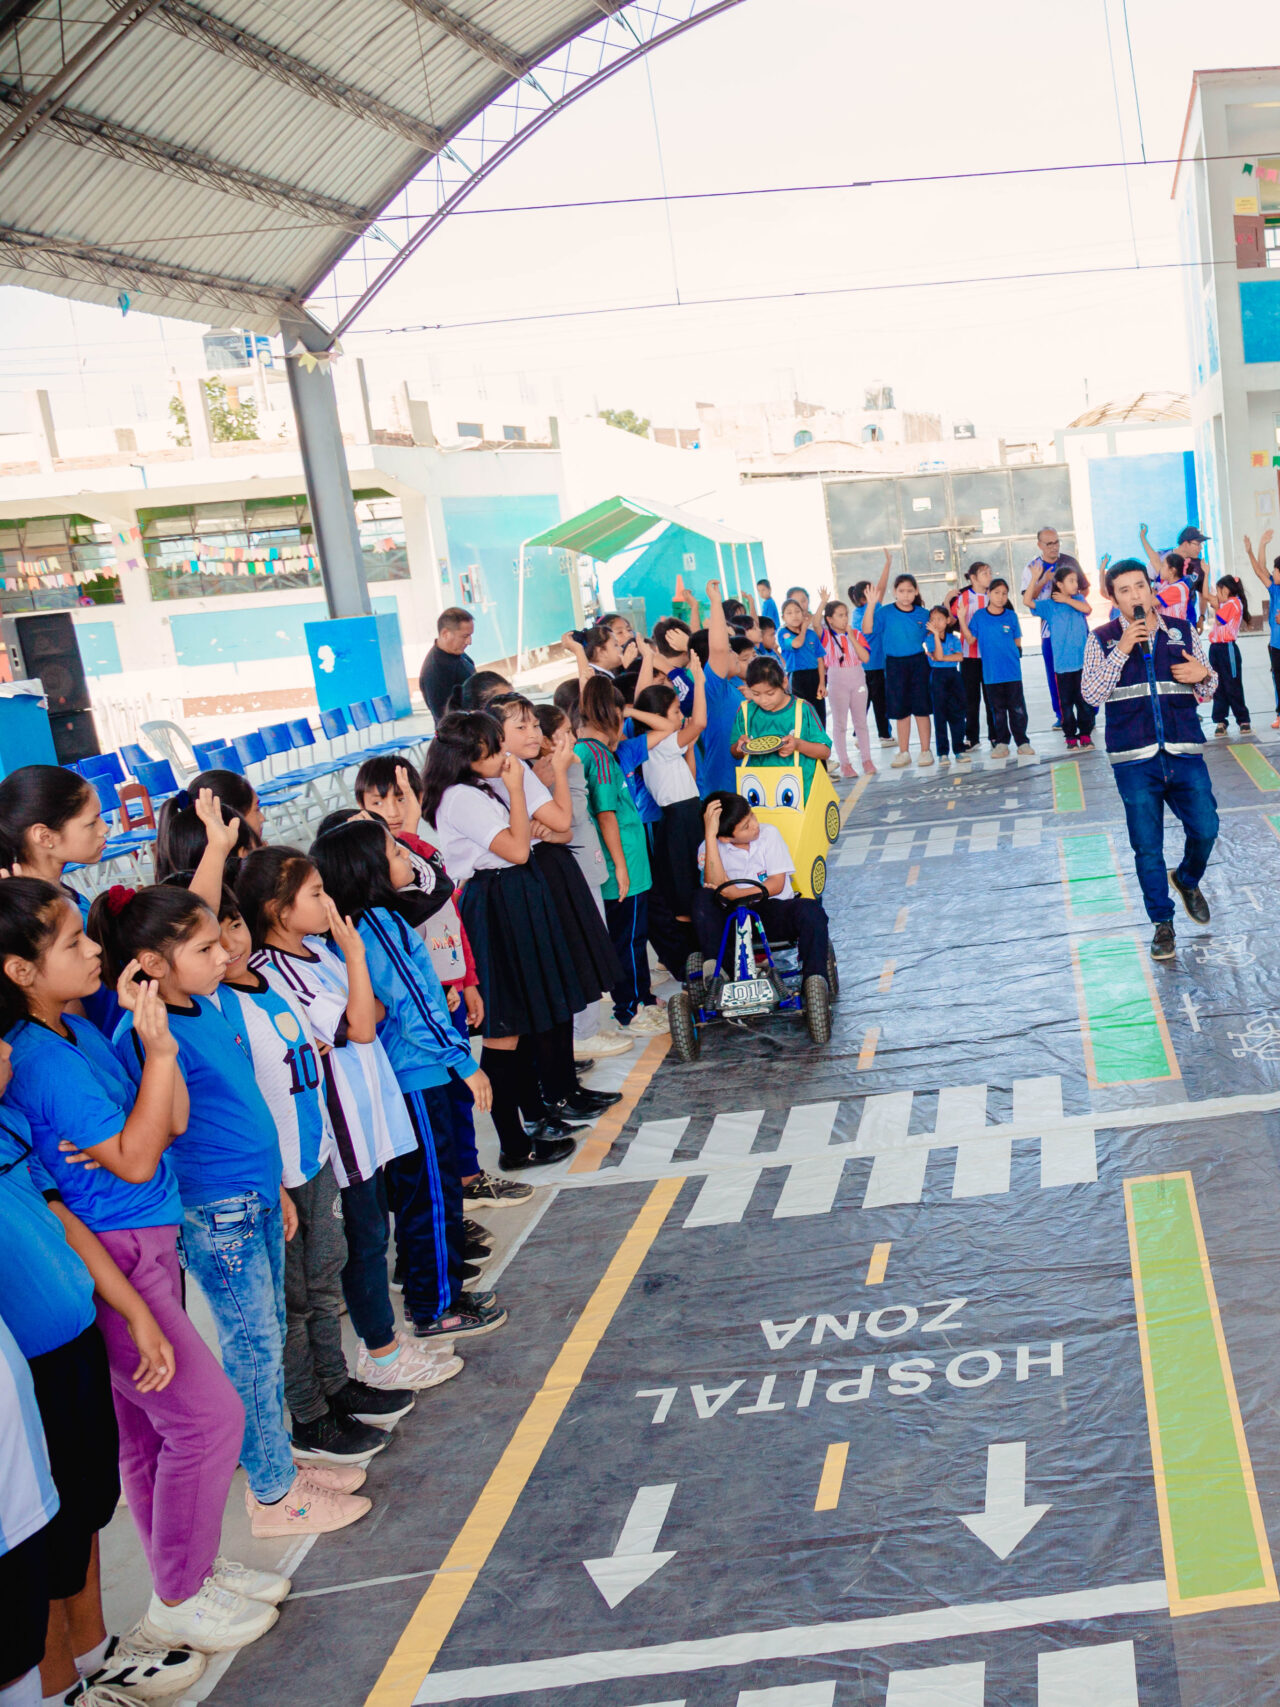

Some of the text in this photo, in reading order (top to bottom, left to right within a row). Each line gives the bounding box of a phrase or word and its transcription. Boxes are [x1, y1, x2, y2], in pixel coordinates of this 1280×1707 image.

[920, 783, 990, 794] ZONA
[734, 983, 758, 1000] 01
[283, 1042, 320, 1096] 10
[759, 1297, 968, 1350] ZONA
[634, 1341, 1064, 1425] HOSPITAL
